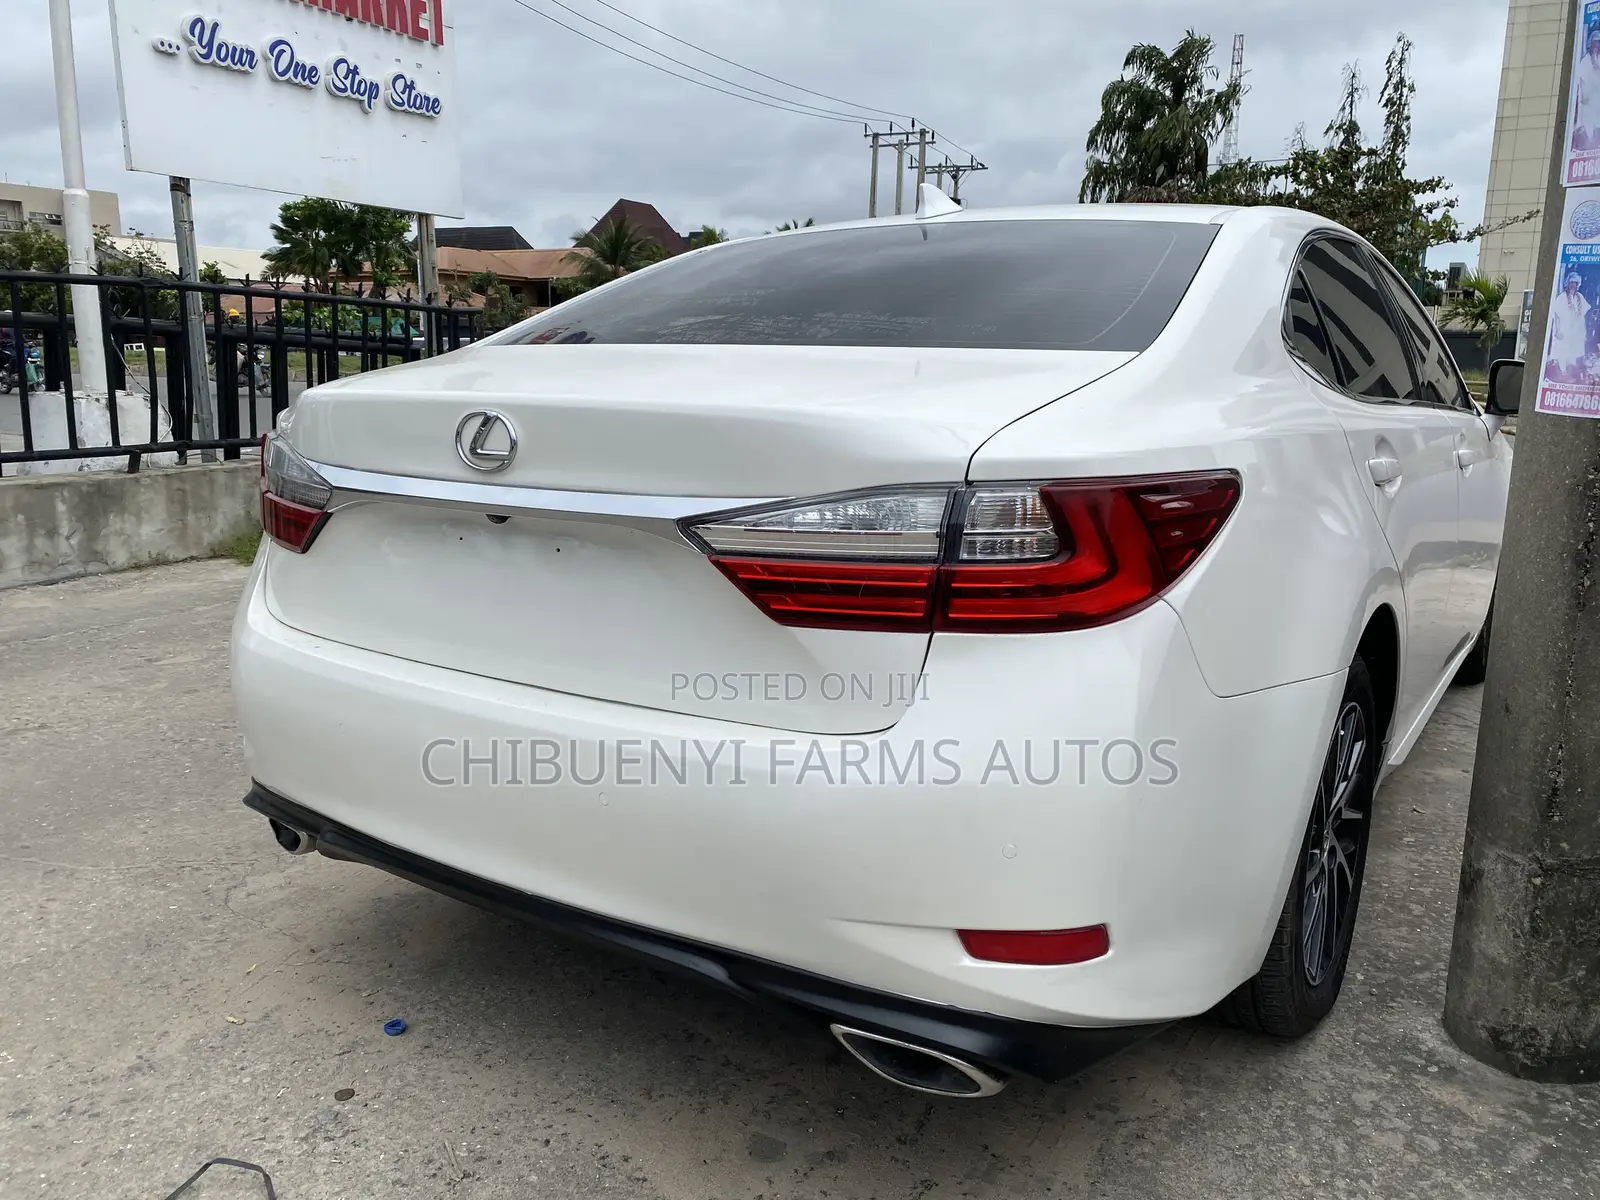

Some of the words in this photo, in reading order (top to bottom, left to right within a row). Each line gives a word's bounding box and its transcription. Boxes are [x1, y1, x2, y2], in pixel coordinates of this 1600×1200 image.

[188, 17, 258, 70] Your
[268, 39, 320, 86] One
[331, 57, 380, 110] Stop
[390, 73, 442, 115] Store
